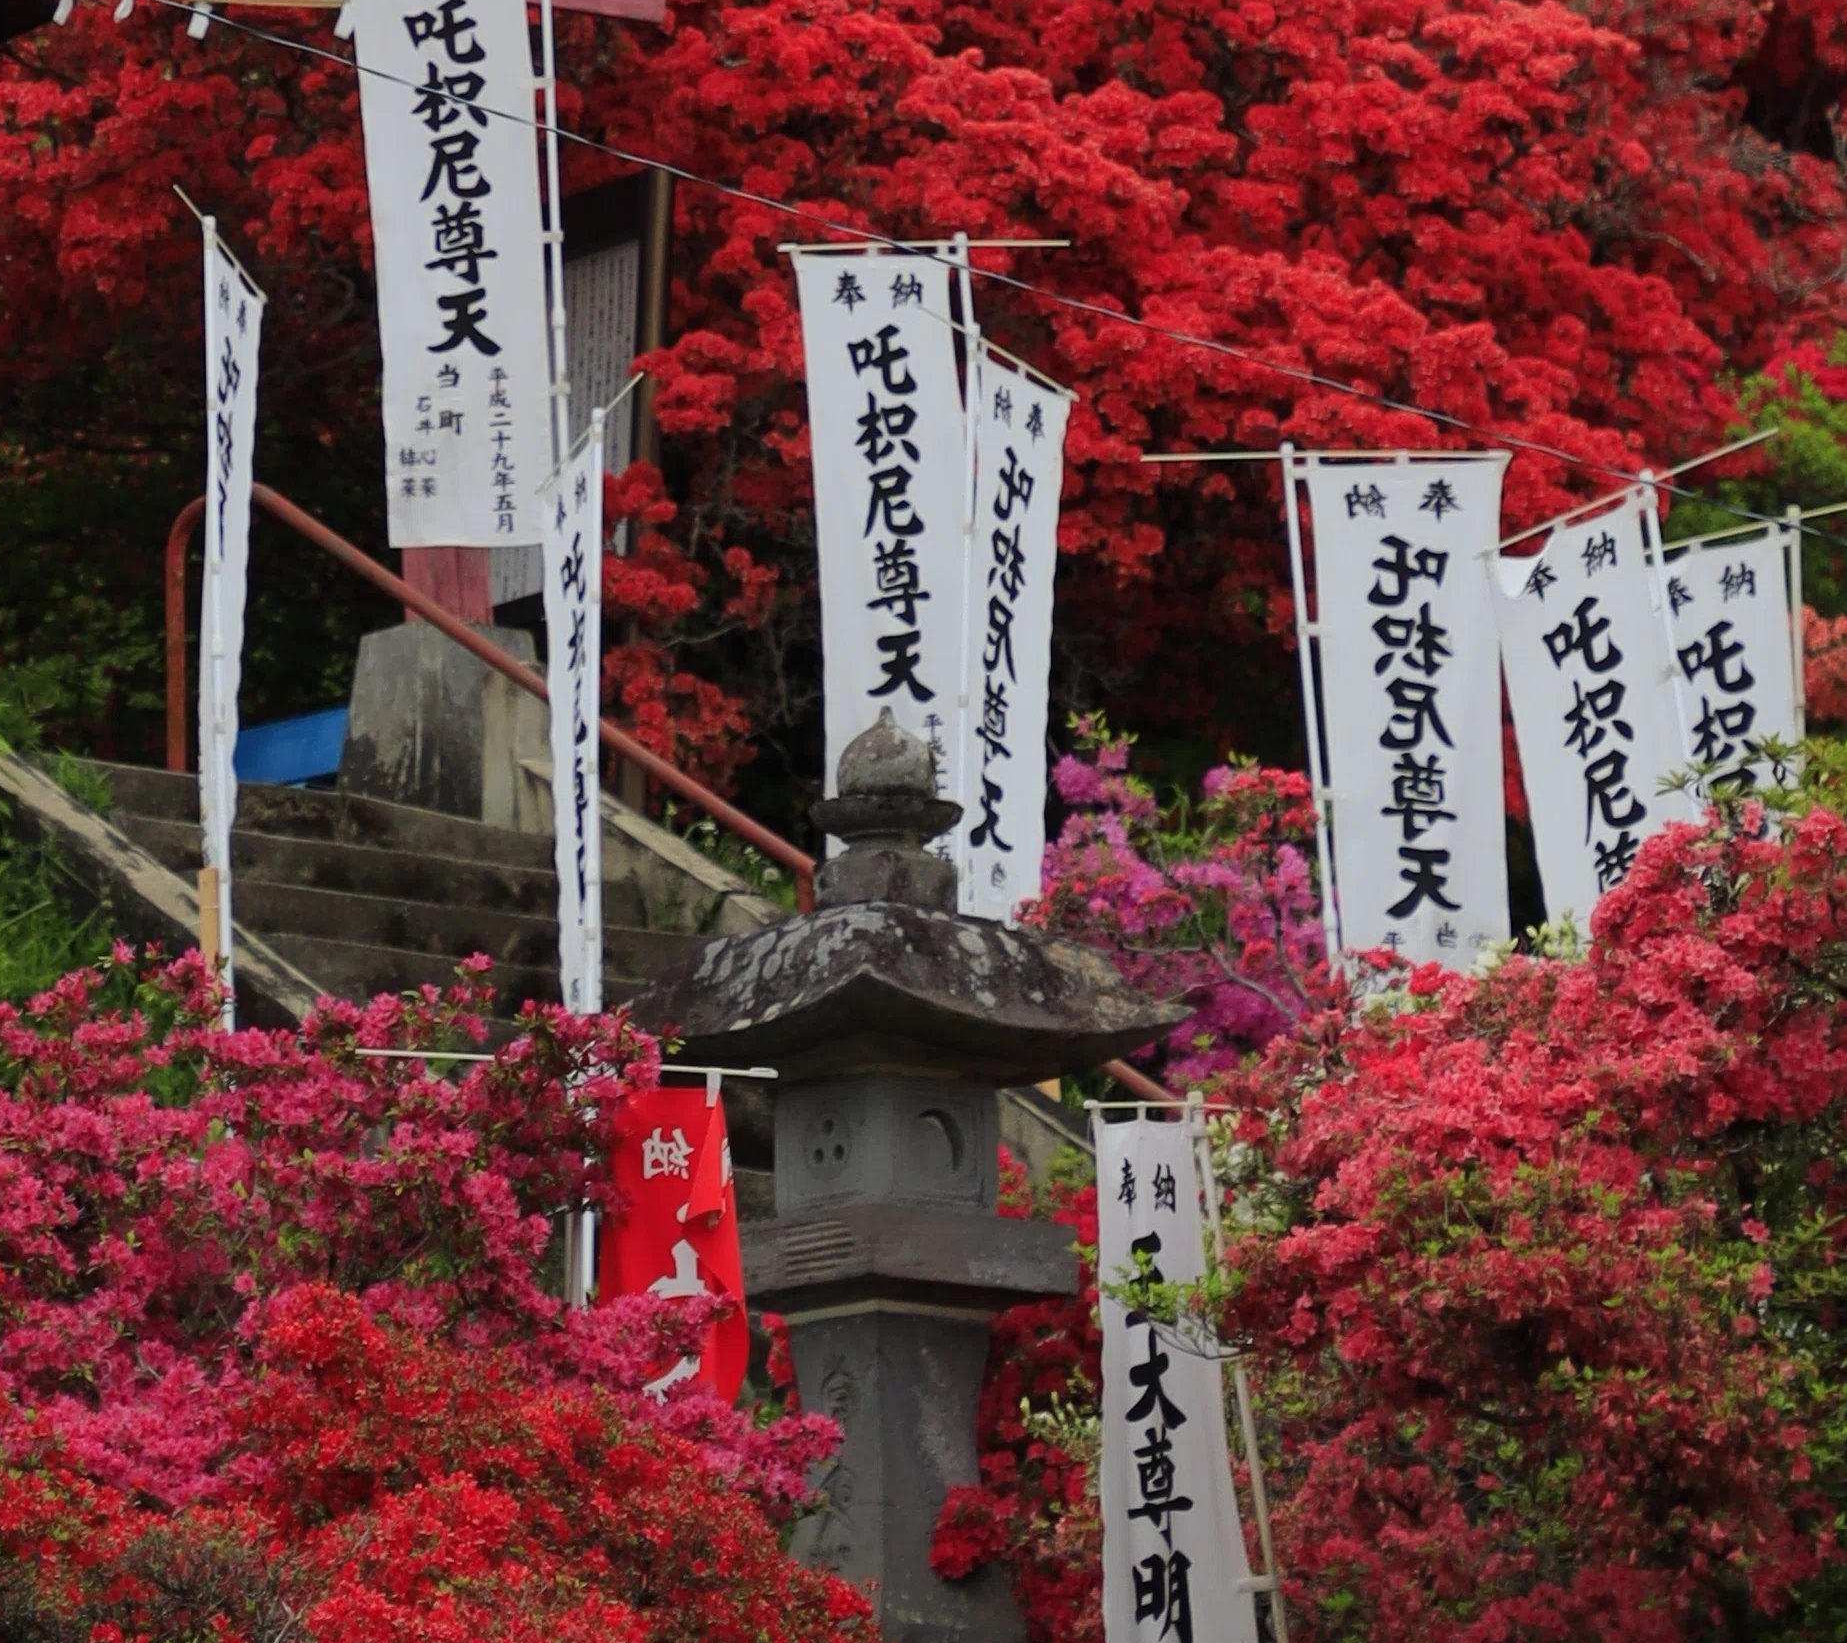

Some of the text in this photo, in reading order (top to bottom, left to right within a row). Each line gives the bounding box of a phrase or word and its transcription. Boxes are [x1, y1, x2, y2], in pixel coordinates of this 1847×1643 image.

[832, 272, 923, 312] 奉納
[437, 363, 464, 435] 当町
[488, 367, 517, 533] 平成二十九年五月
[1524, 529, 1618, 601] 奉納
[1117, 1157, 1176, 1215] 奉納
